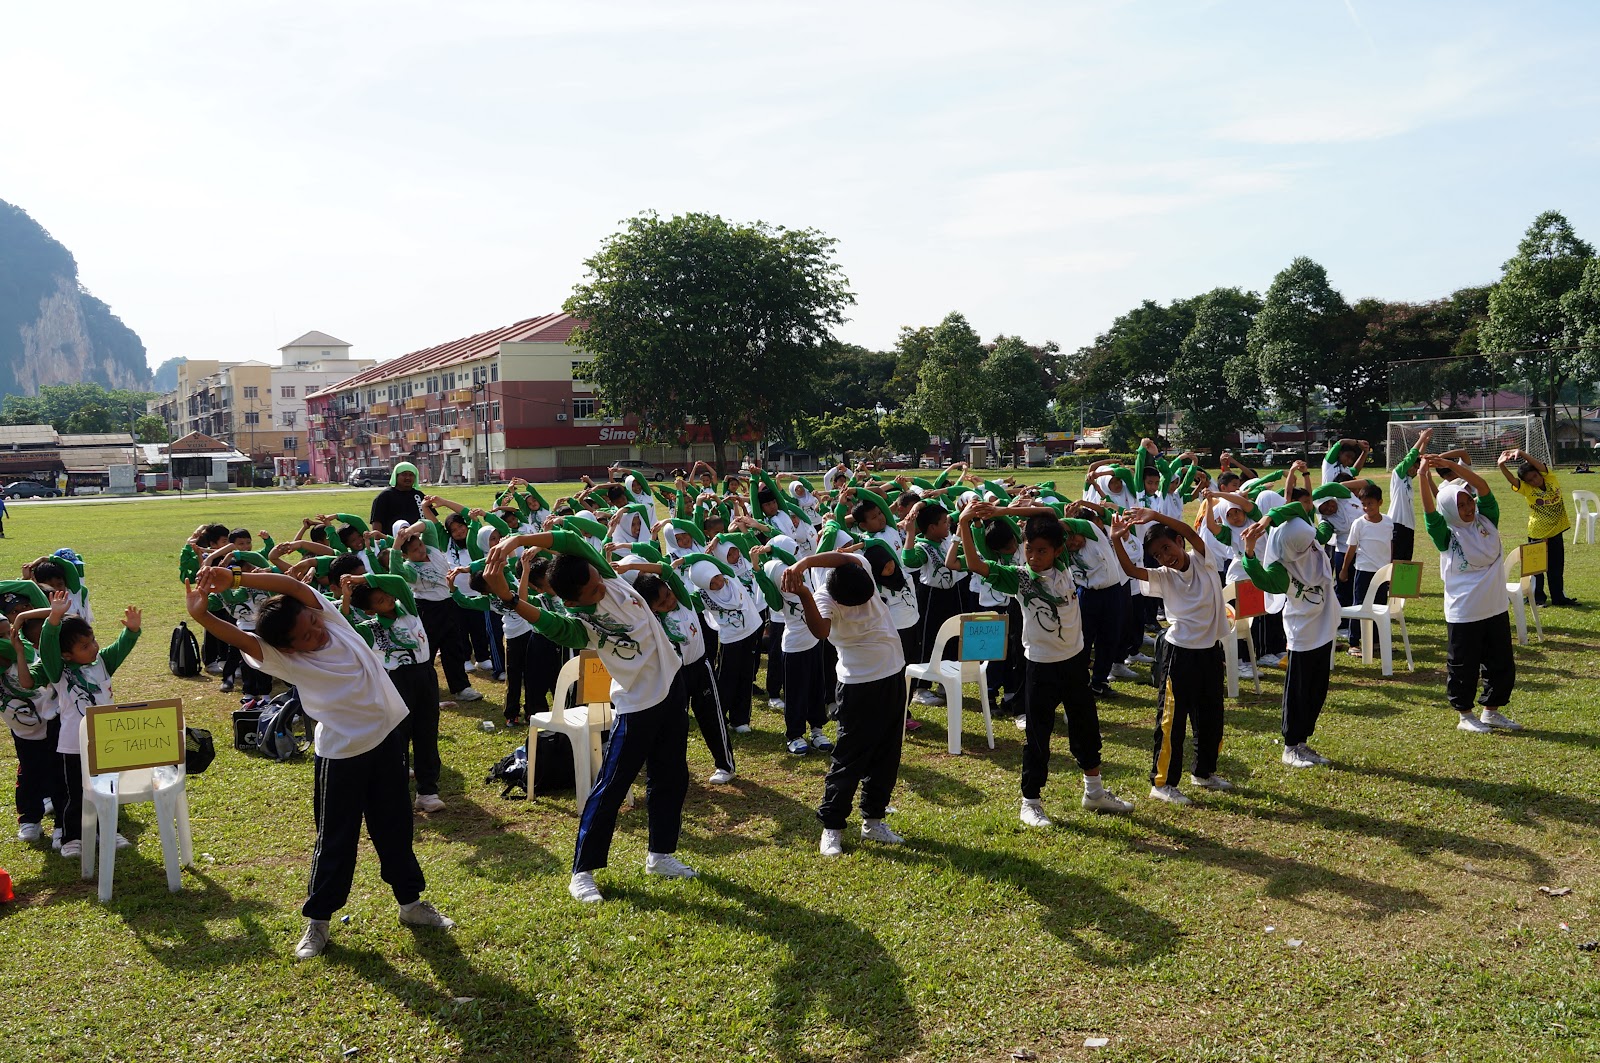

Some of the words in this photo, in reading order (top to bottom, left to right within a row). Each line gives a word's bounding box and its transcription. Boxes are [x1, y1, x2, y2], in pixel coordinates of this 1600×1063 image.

[599, 428, 636, 442] Sime
[969, 625, 1000, 636] DARJAH
[979, 639, 987, 651] 2
[592, 662, 608, 674] DA
[105, 715, 167, 732] TADIKA
[104, 739, 116, 754] 6
[123, 735, 171, 752] TAHUN
